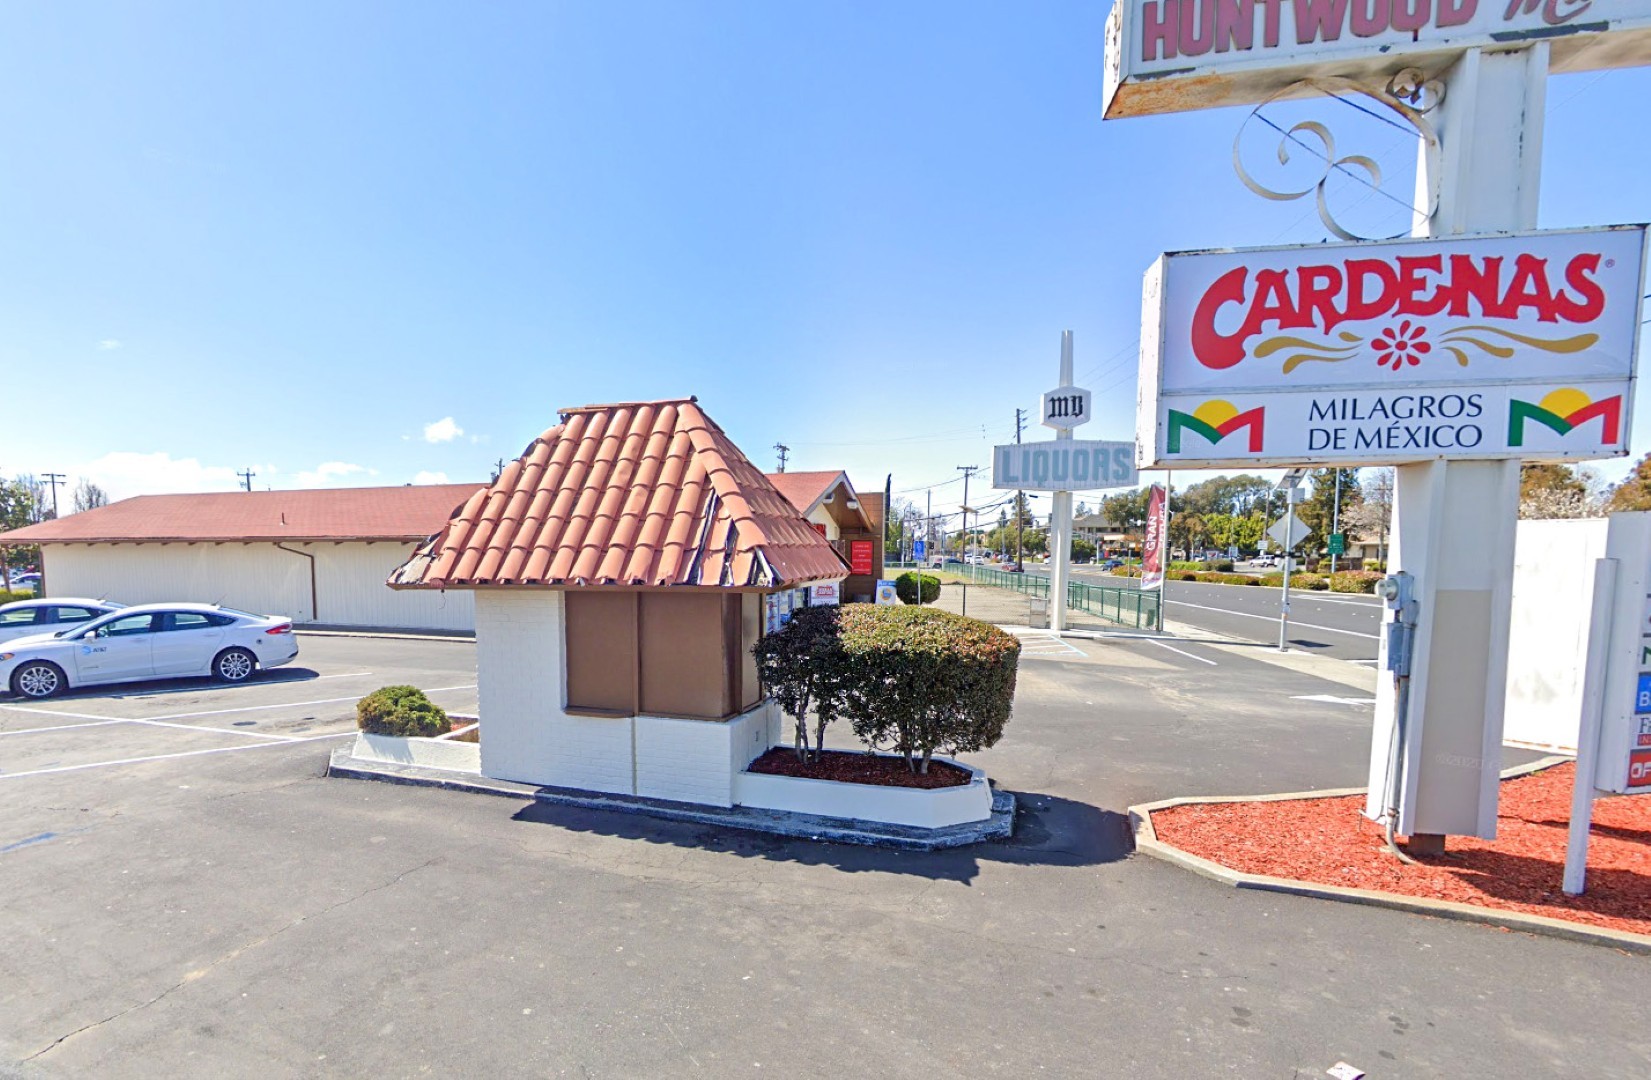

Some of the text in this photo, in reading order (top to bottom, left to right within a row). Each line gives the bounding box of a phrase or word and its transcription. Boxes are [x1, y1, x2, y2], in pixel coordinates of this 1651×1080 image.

[1191, 253, 1605, 370] CARDENAS
[1308, 393, 1483, 421] MILAGROS
[1308, 420, 1483, 450] DE MÉXICO
[1002, 447, 1132, 488] LIQUORS
[1146, 515, 1158, 551] GRAN
